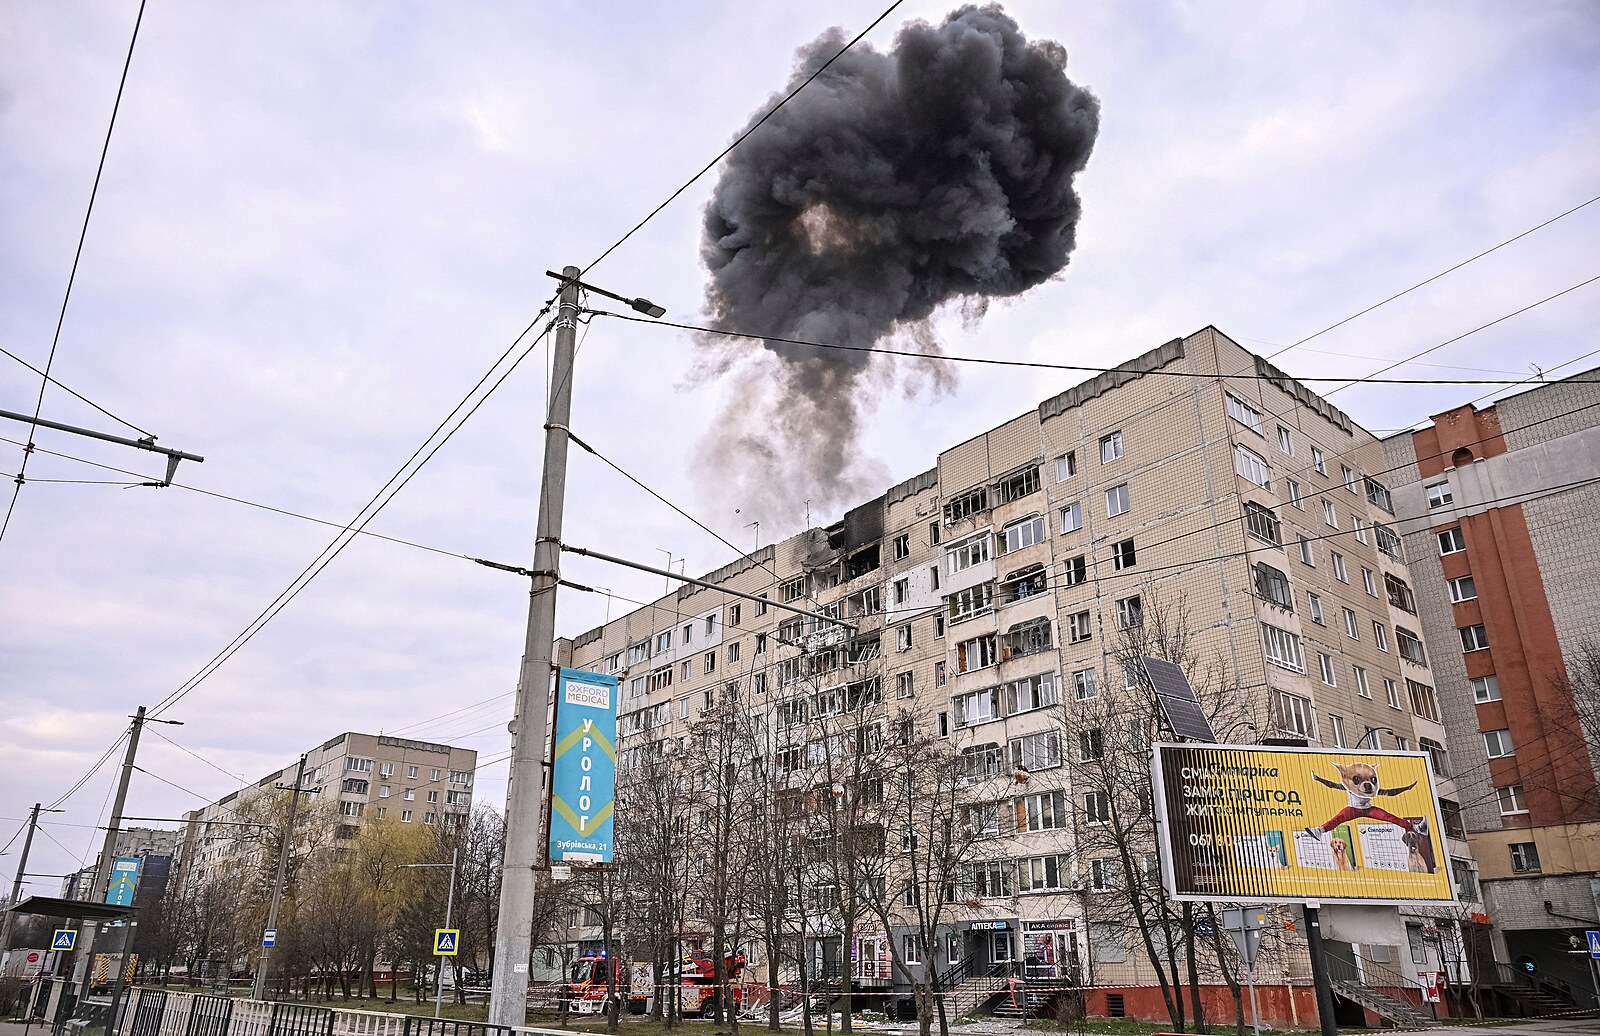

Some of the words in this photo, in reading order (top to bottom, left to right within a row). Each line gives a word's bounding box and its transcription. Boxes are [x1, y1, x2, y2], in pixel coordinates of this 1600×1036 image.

[568, 684, 608, 698] OXFORD
[568, 692, 608, 706] MEDICAL
[579, 718, 593, 831] УРОЛОГ
[557, 840, 599, 851] Зубрівська,
[599, 842, 607, 850] 21
[971, 922, 997, 930] АПТЕКА
